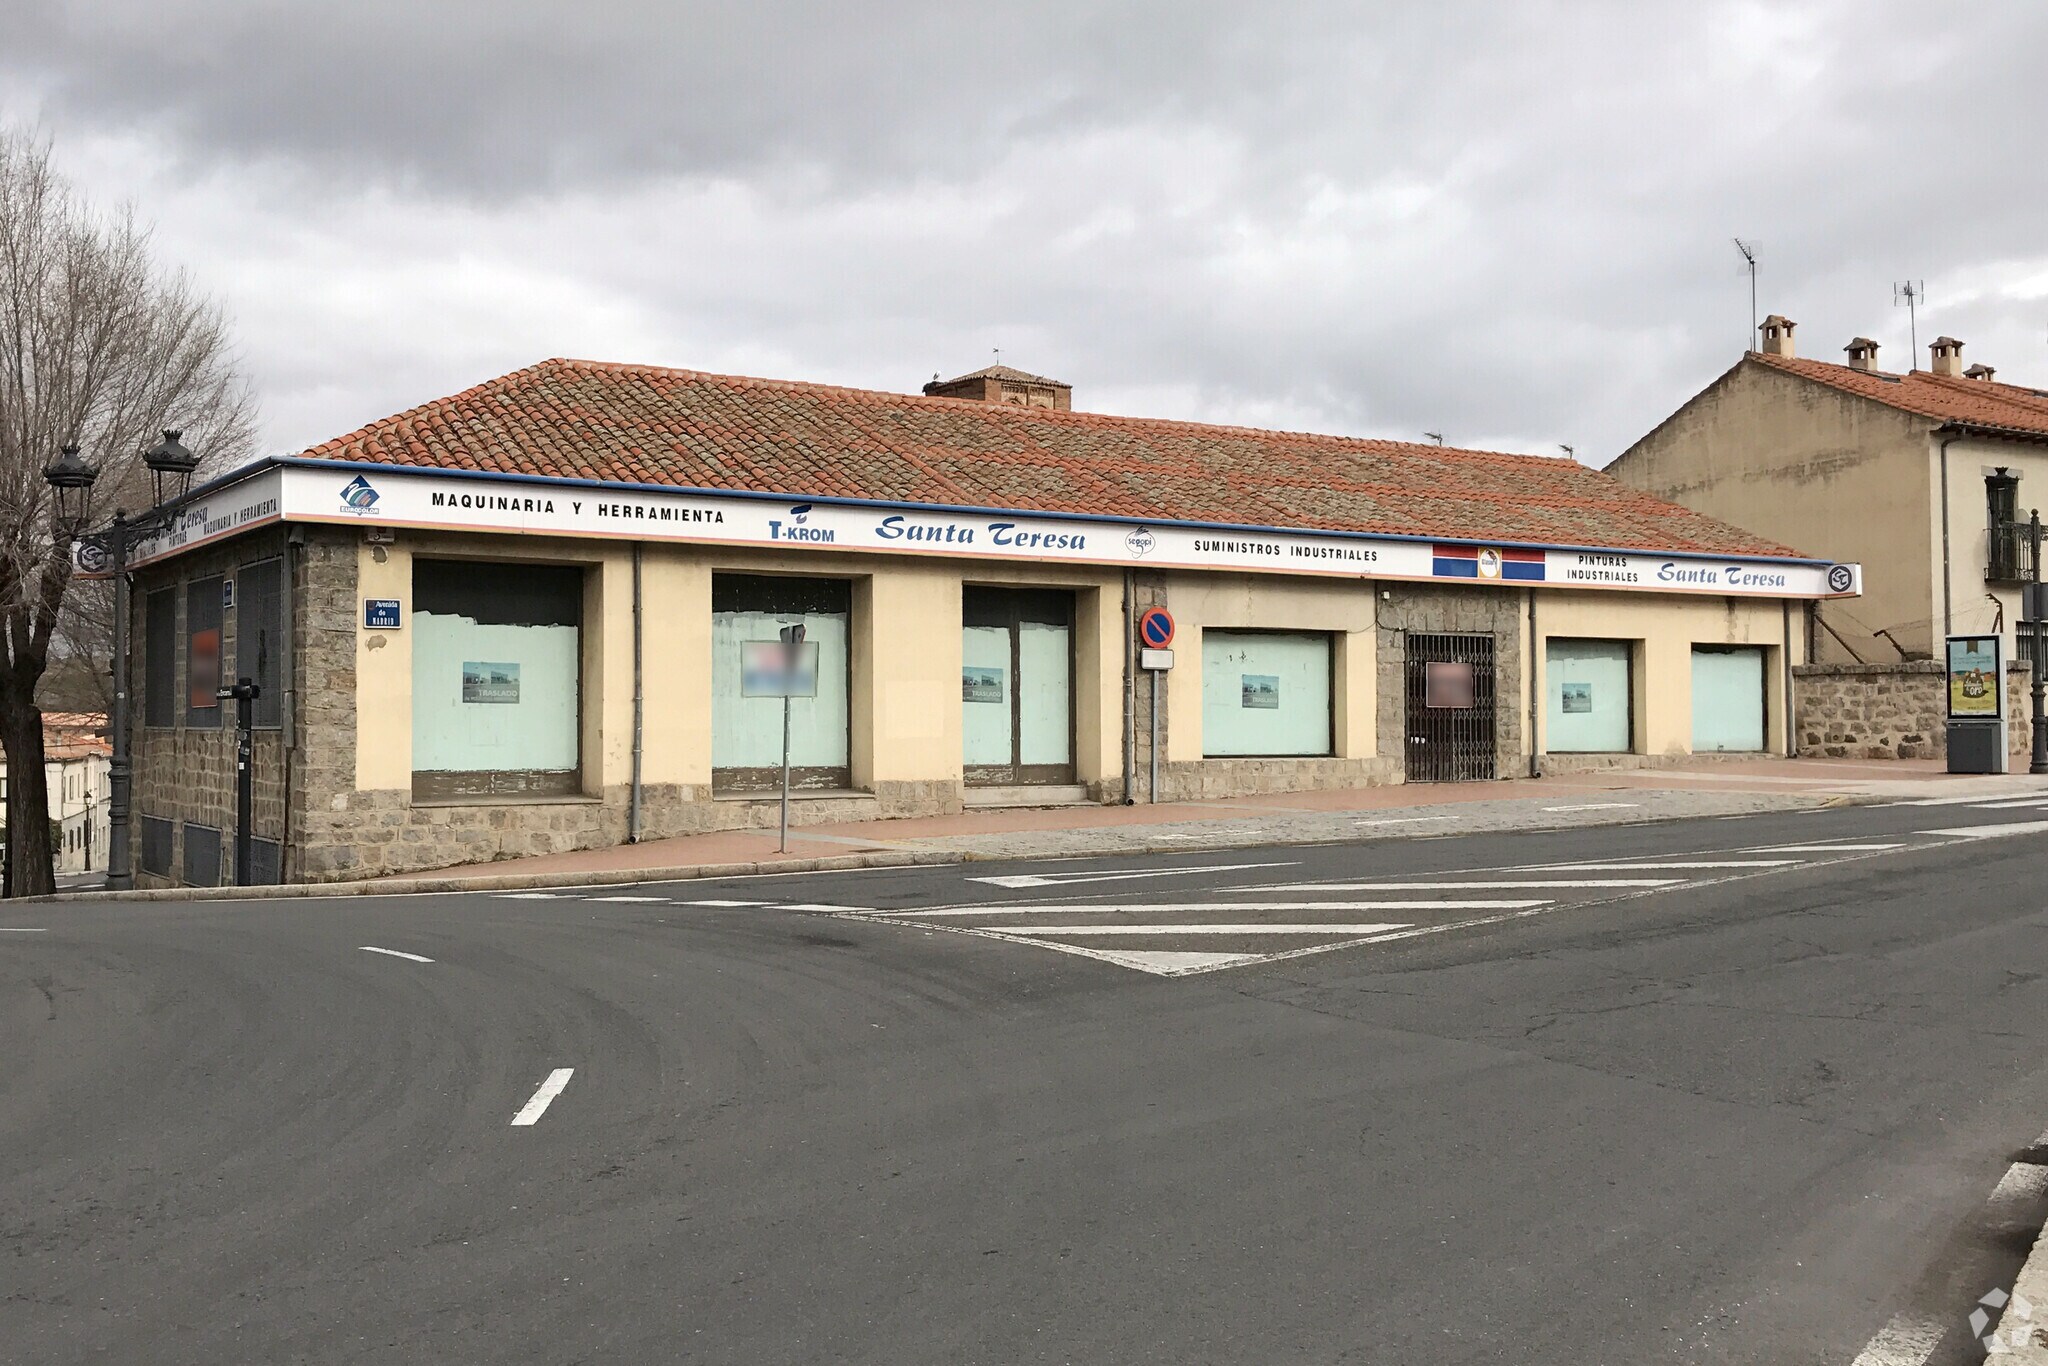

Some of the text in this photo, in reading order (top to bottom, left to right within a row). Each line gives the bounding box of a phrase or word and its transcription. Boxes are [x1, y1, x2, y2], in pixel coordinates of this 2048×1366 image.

[203, 514, 231, 535] MAQUINARIA
[240, 498, 277, 522] HERRAMIENTA
[432, 492, 724, 524] MAQUINARIA Y HERRAMIENTA
[875, 515, 1086, 550] Santa Teresa
[1194, 540, 1378, 561] SUMINISTROS INDUSTRIALES
[1578, 555, 1627, 567] PINTURAS
[1567, 569, 1639, 582] INDUSTRIALES
[1657, 562, 1786, 587] Santa Teresa
[372, 617, 394, 625] MADRID
